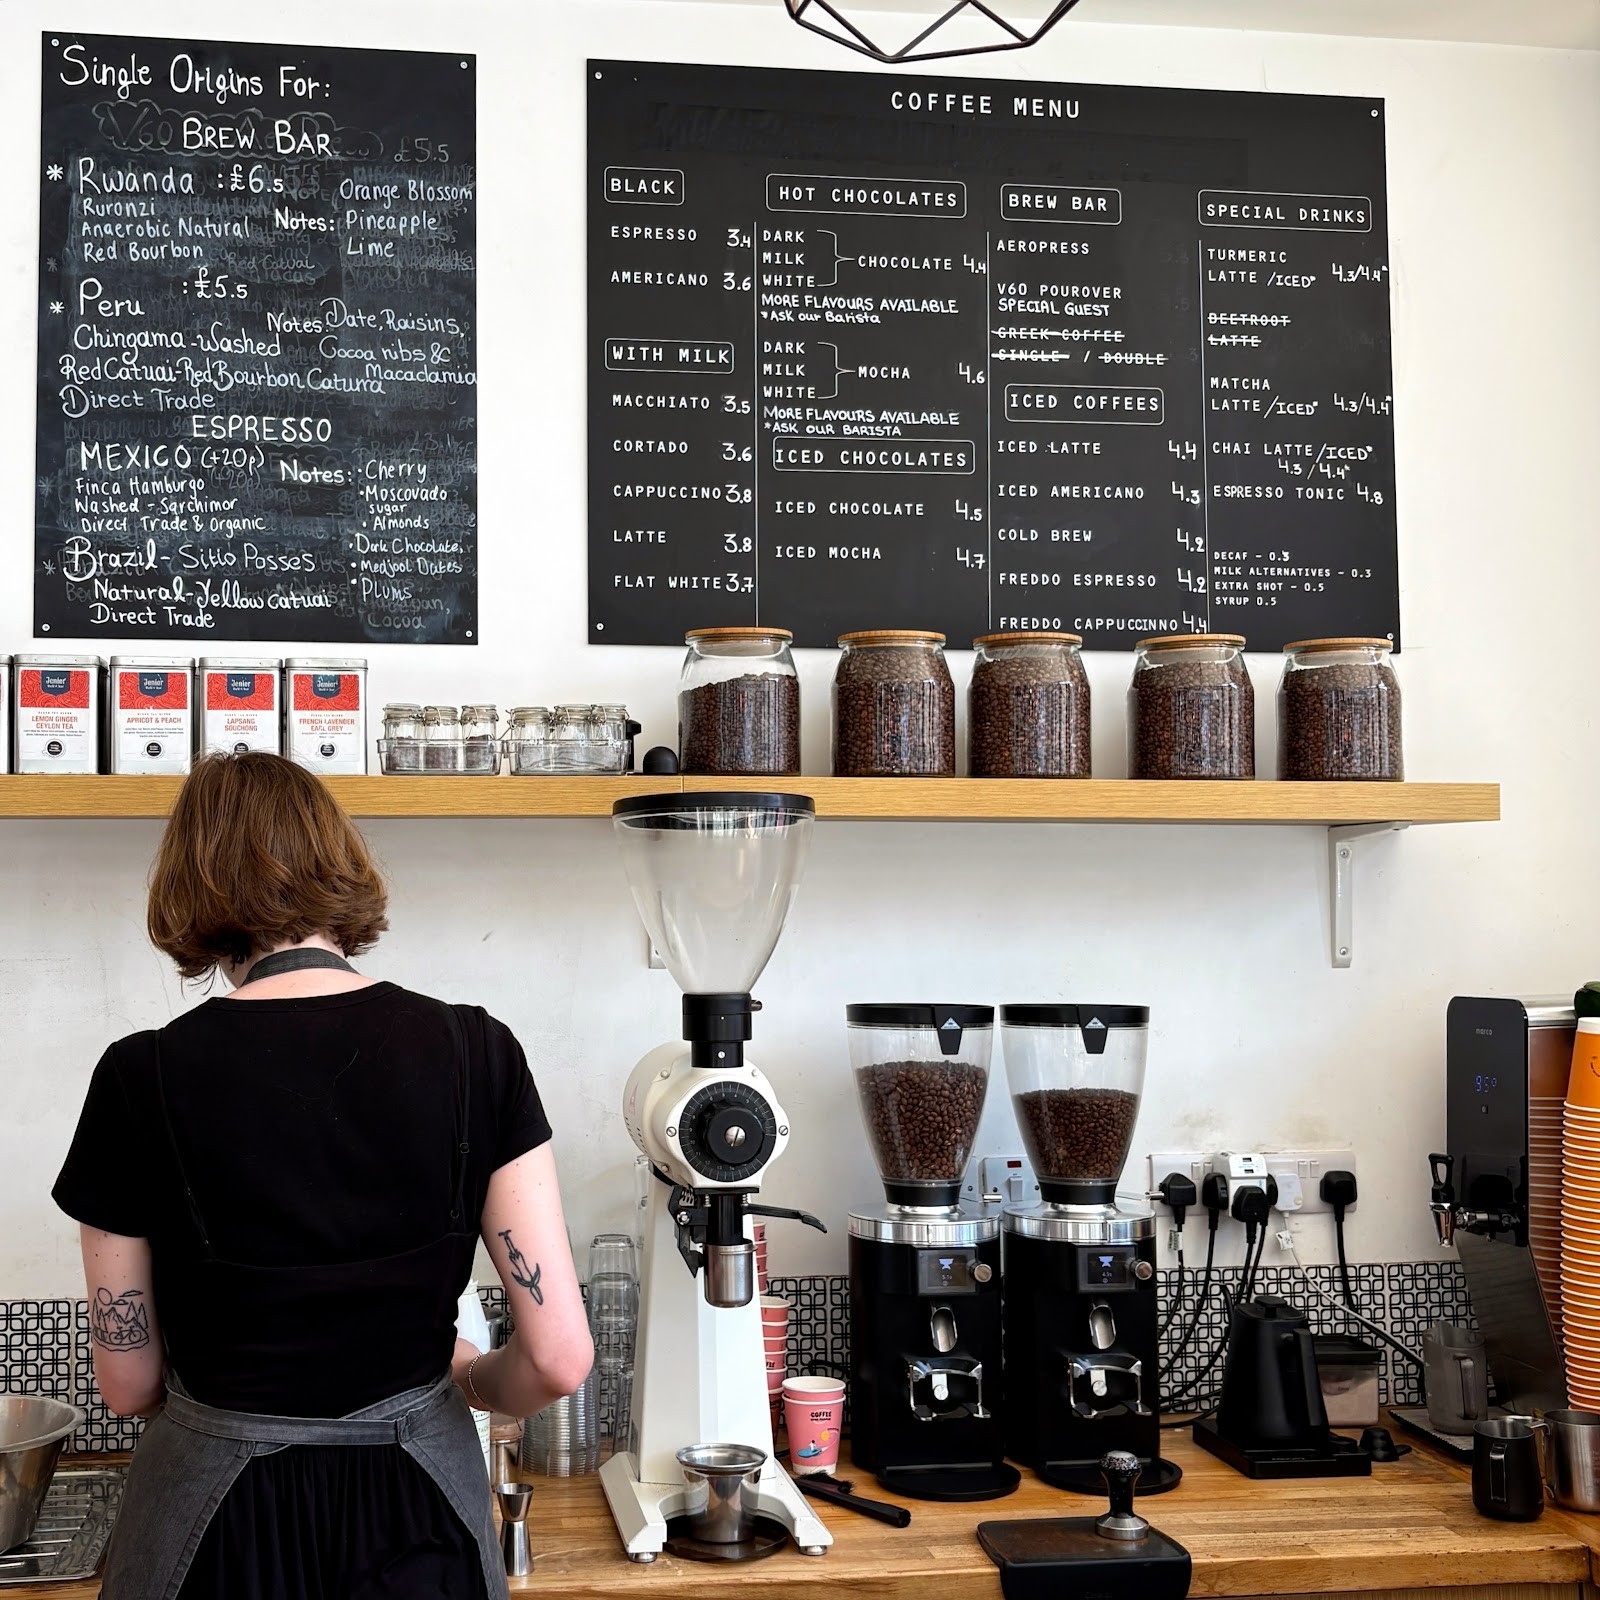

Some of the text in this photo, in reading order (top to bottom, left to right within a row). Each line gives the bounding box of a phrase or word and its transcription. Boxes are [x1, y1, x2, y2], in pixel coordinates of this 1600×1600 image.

[60, 44, 331, 104] Single Origins For:
[891, 91, 1080, 118] COFFEE MENU
[183, 117, 333, 157] BREW BAR
[79, 157, 194, 194] Rwanda
[340, 178, 473, 210] Orange Blossom
[610, 178, 675, 195] BLACK
[779, 186, 957, 207] HOT CHOCOLATES
[83, 197, 155, 217] Ruronzi
[1008, 193, 1108, 212] BREW BAR
[275, 207, 335, 232] Notes:
[346, 209, 438, 236] Pineapple
[1206, 203, 1366, 224] SPECIAL DRINKS
[82, 215, 250, 239] Anaerobic Natural
[611, 225, 751, 248] ESPRESSO 3.4
[763, 229, 805, 243] DARK
[84, 240, 203, 264] Red Bourbon
[347, 236, 395, 258] Lime
[996, 239, 1090, 255] AEROPRESS
[1207, 248, 1287, 263] TURMERIC
[762, 252, 987, 275] MILK CHOCOLATE 4.4
[610, 270, 751, 291] AMERICANO 3.6
[762, 274, 815, 288] WHITE
[1208, 270, 1257, 283] LATTE
[79, 277, 146, 317] Peru
[997, 283, 1122, 299] V60 POUROVER
[761, 293, 960, 314] MORE FLAVOURS AVAILABLE
[998, 298, 1110, 316] SPECIAL GUEST
[1208, 313, 1290, 327] BEETROOT
[73, 323, 187, 365] Chingama
[1061, 329, 1124, 343] COFFEE
[319, 335, 426, 362] Cocoa nibs
[612, 346, 730, 364] WITH MILK
[763, 341, 806, 355] DARK
[365, 363, 477, 386] Macadamia
[763, 362, 986, 385] MILK MOCHA 4.6
[1210, 377, 1270, 390] MATCHA
[59, 384, 216, 419] Direct Trade
[763, 386, 817, 400] WHITE
[1010, 393, 1160, 412] ICED COFFEES
[612, 394, 751, 414] MACCHIATO 3.5
[1211, 399, 1261, 411] LATTE
[763, 405, 961, 426] MORE FLAVOURS AVAILABLE
[192, 414, 332, 443] ESPRESSO
[843, 424, 902, 437] BARISTA
[80, 441, 192, 472] MEXICO
[613, 439, 752, 462] CORTADO 3.6
[775, 449, 967, 468] ICED CHOCOLATES
[998, 440, 1198, 461] ICED LATTE 4.4
[1212, 442, 1313, 456] CHAI LATTE
[280, 459, 353, 484] Notes:
[76, 477, 205, 499] Finca Hamburgo
[613, 484, 752, 504] CAPPUCCINO 3.8
[998, 480, 1201, 505] ICED AMERICANO 4.3
[1213, 482, 1383, 505] ESPRESSO TONIC 4.8
[75, 496, 238, 516] Washed Sarchimor
[370, 502, 408, 517] sugar
[775, 499, 983, 521] ICED CHOCOLATE 4.5
[81, 515, 266, 538] Direct Trade Organic
[374, 516, 430, 531] Almonds
[613, 530, 753, 553] LATTE 3.8
[998, 527, 1205, 552] COLD BREW 4.2
[179, 543, 316, 573] Sitio Posses
[417, 557, 463, 574] Dates
[775, 546, 986, 570] ICED MOCHA 4.7
[1214, 552, 1248, 560] DECAF
[614, 572, 754, 593] FLAT WHITE 3.7
[999, 567, 1207, 593] FREDDO ESPRESSO 4.2
[1214, 567, 1371, 578] MILK ALTERNATIVES 0.3
[1214, 582, 1325, 591] EXTRA SHOT 0.5
[1215, 597, 1277, 606] SYRUP 0.5
[89, 602, 216, 629] Direct Trade
[999, 617, 1062, 630] FREDDO
[1182, 610, 1208, 634] 4.4
[31, 715, 54, 723] LEMON
[1476, 1028, 1492, 1036] marco
[810, 1410, 832, 1418] COFFEE
